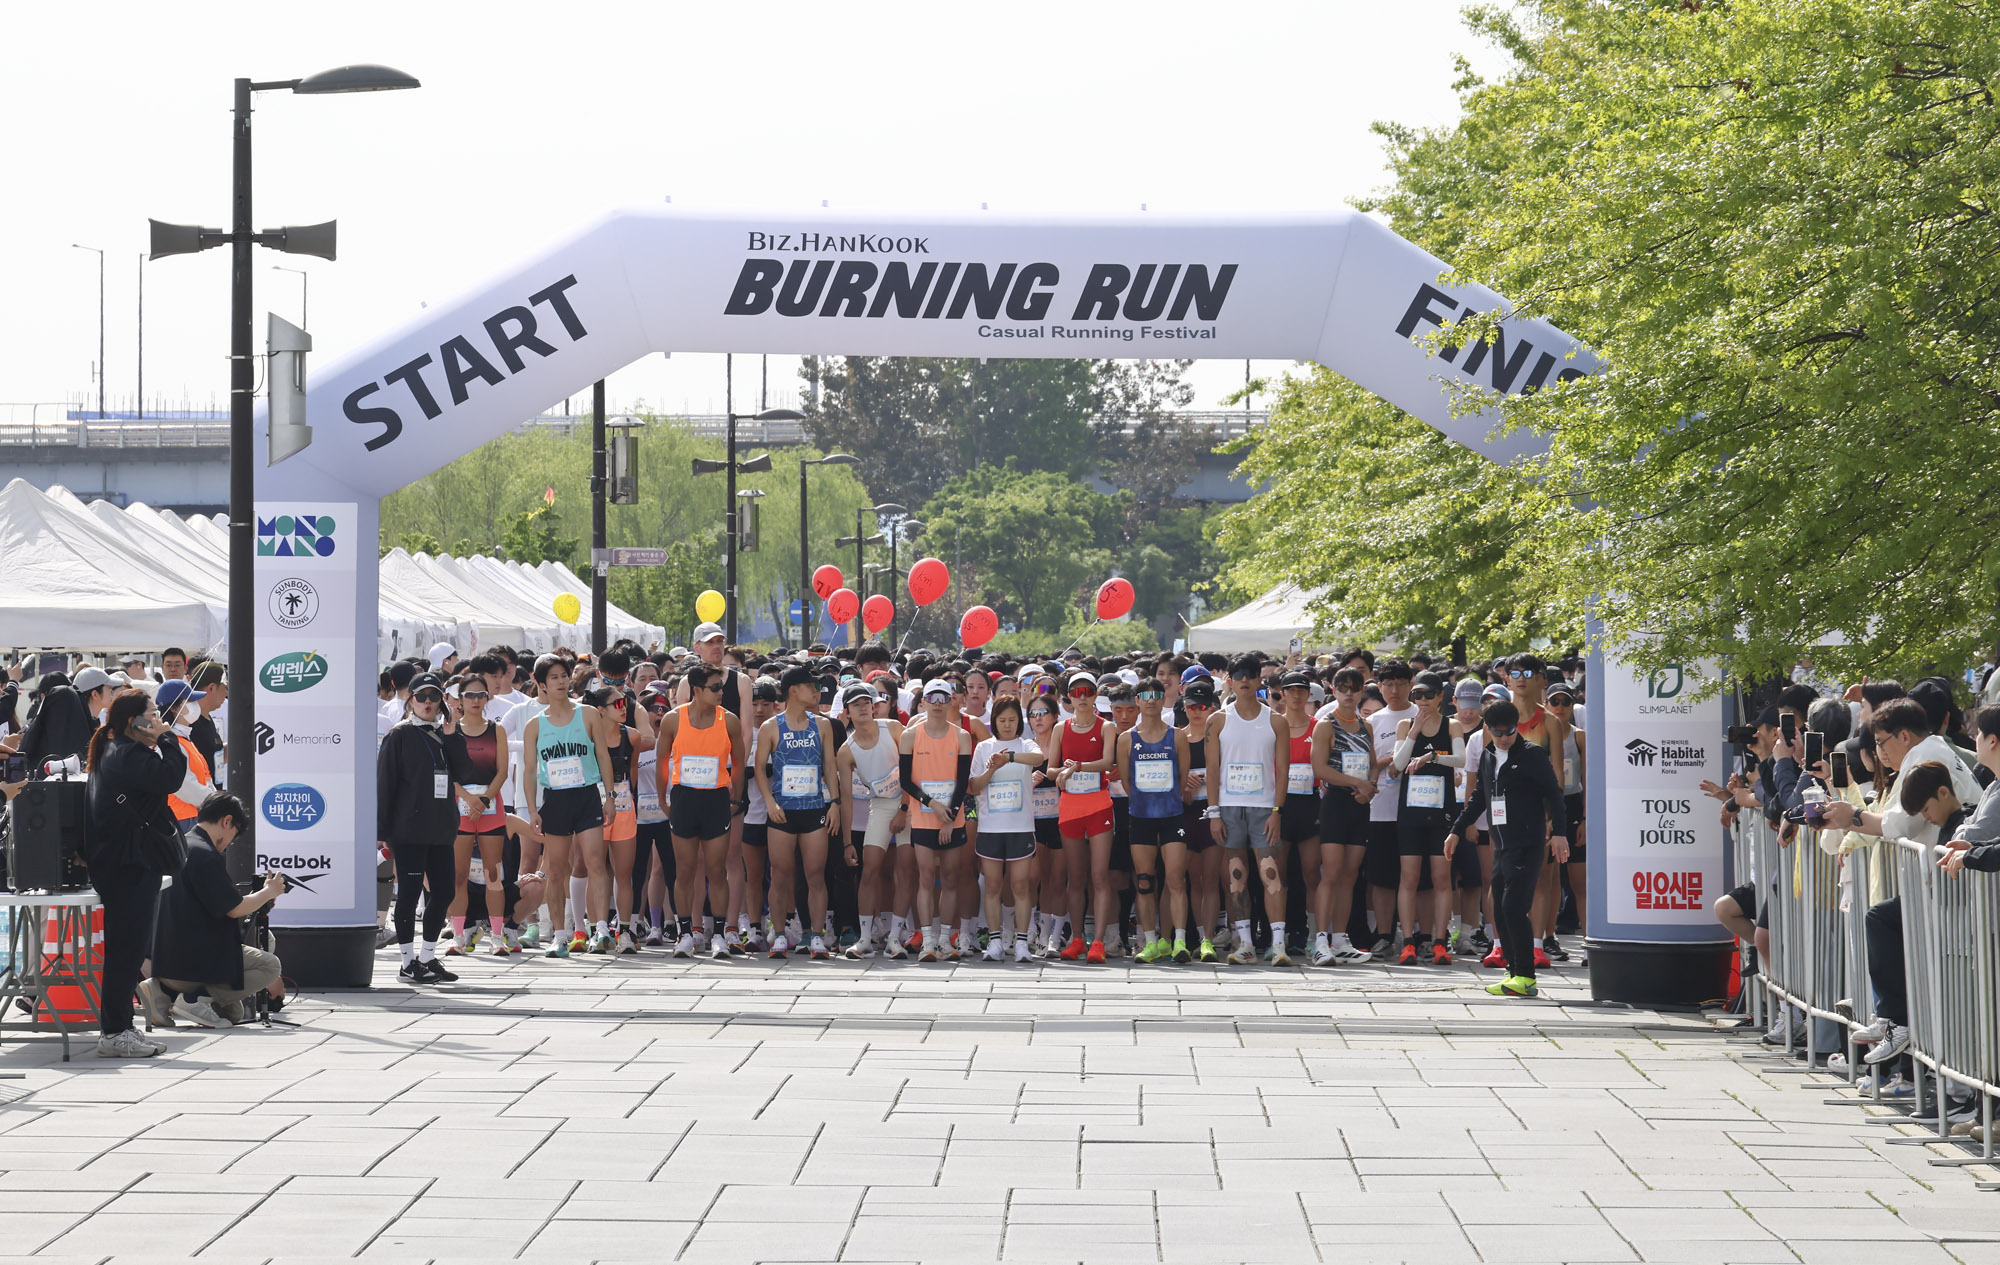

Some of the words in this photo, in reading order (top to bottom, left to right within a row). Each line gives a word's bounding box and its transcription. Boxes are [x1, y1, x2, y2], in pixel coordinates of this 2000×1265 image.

[723, 257, 1060, 321] BURNING
[1071, 263, 1239, 322] RUN
[977, 324, 1046, 339] Casual
[1051, 325, 1134, 342] Running
[1140, 325, 1217, 340] Festival
[342, 273, 588, 452] START
[274, 580, 313, 596] SUNBODY
[277, 614, 310, 627] TANNING
[266, 660, 323, 687] 셀렉스
[1638, 705, 1693, 714] SLIMPLANET
[283, 733, 342, 745] MemorinG
[785, 739, 816, 749] KOREA
[1138, 752, 1169, 760] DESCENTE
[1661, 746, 1705, 759] Habitat
[1661, 759, 1672, 767] for
[1673, 759, 1705, 768] Humanity
[557, 767, 580, 776] 7395
[690, 767, 714, 775] 7347
[1146, 771, 1169, 779] 7222
[1236, 774, 1259, 782] 7111
[274, 792, 311, 803] 천지차이
[996, 791, 1018, 800] 8134
[1641, 799, 1691, 814] TOUS
[268, 804, 318, 823] 백산수
[1657, 815, 1676, 829] les
[1638, 829, 1696, 848] JOURS
[256, 853, 332, 871] Reebok
[1632, 871, 1703, 910] 일요신문
